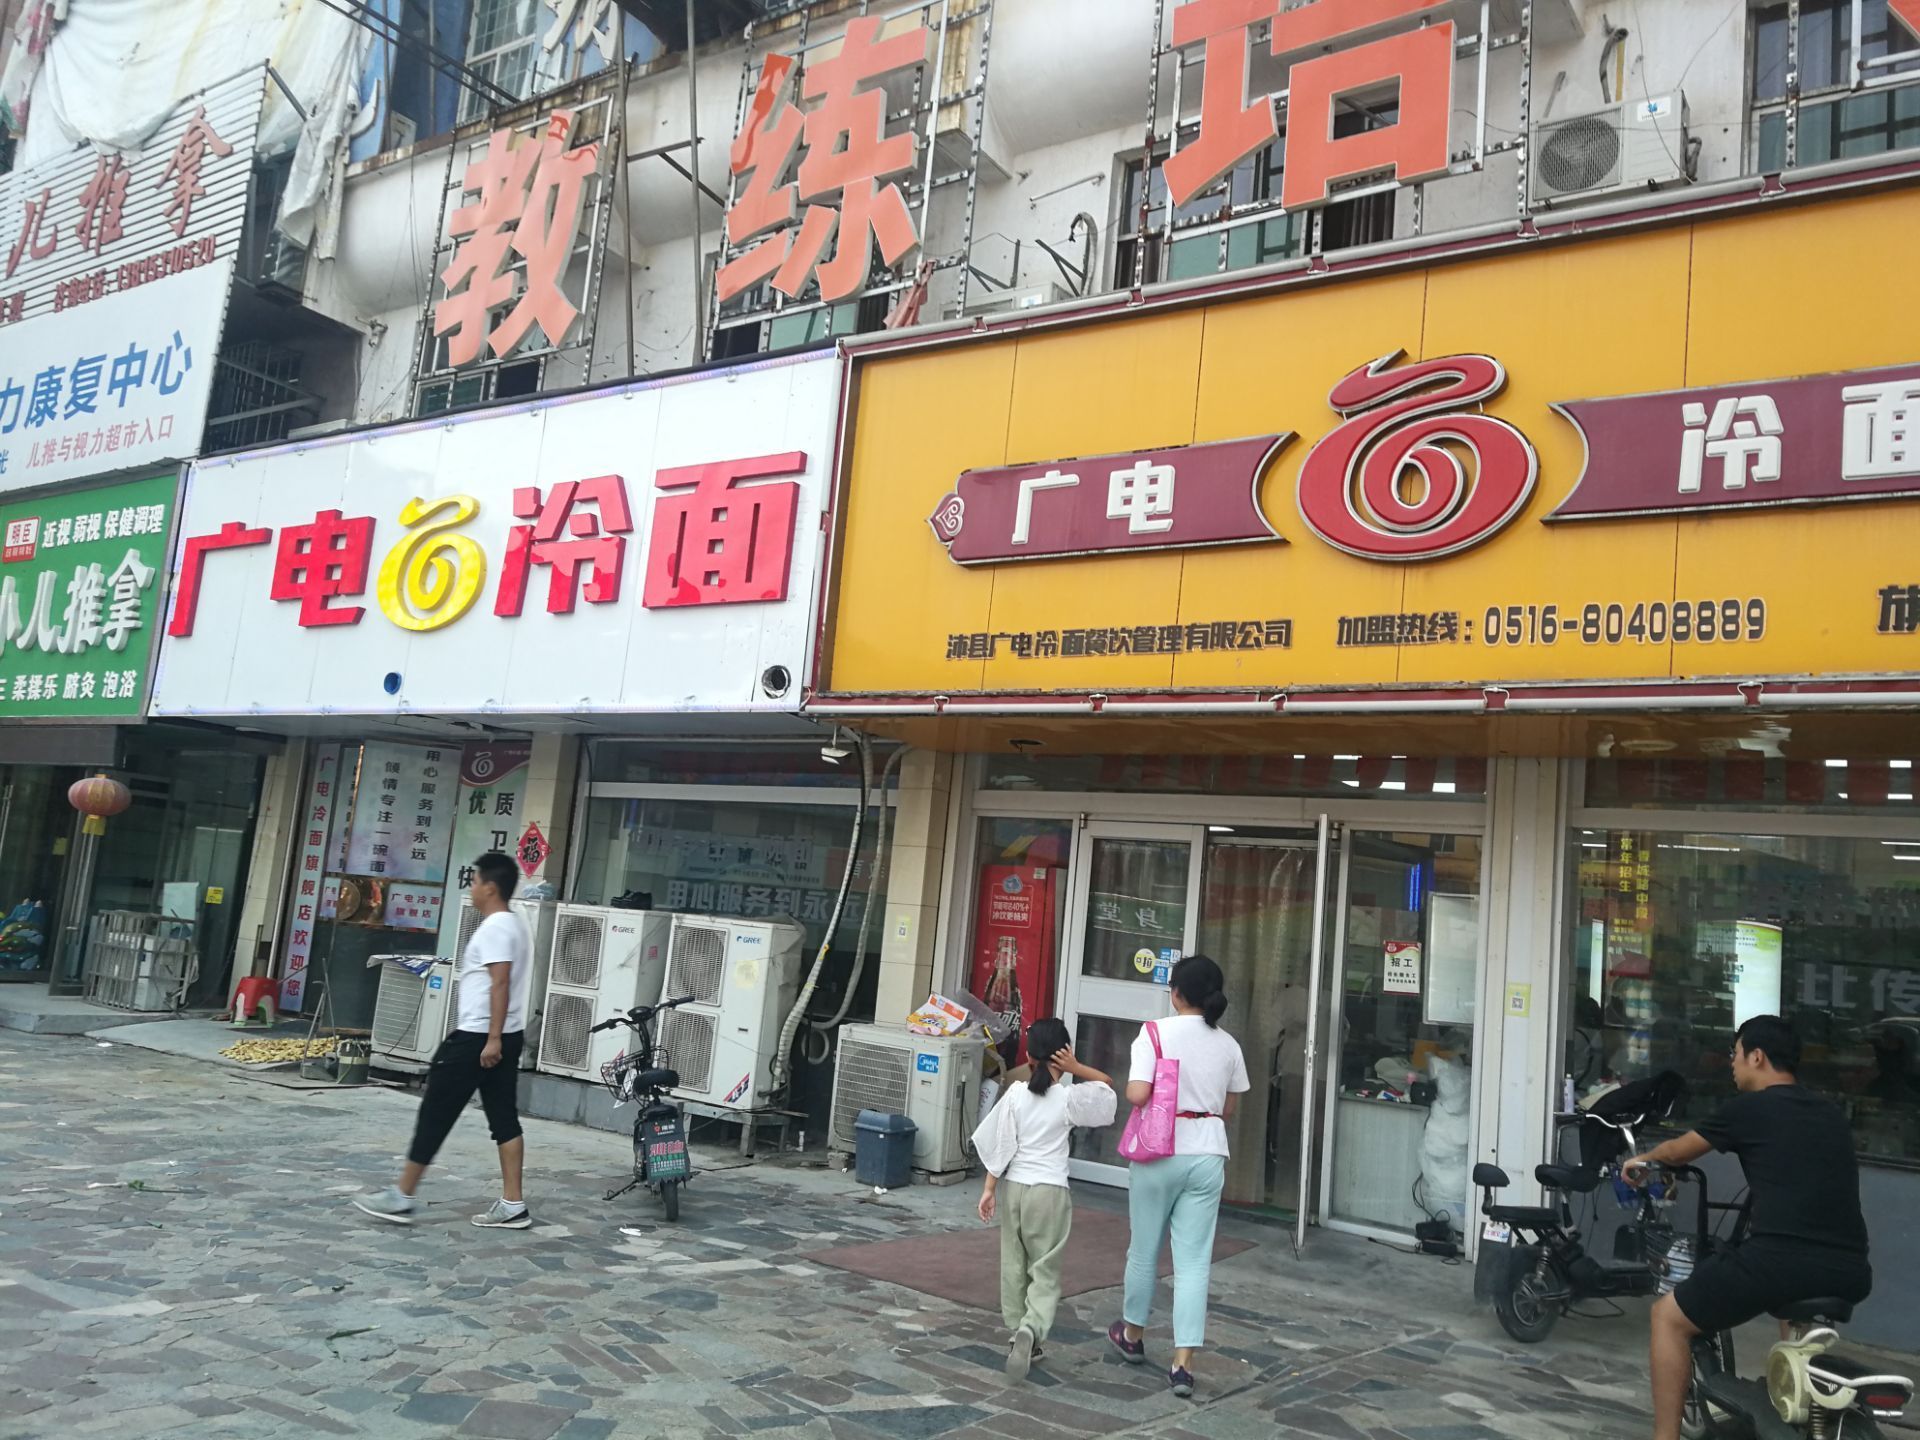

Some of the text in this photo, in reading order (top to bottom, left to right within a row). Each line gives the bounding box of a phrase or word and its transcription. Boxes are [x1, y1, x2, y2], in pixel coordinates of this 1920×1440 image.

[0, 329, 192, 434] 力康复中心
[26, 414, 173, 469] 儿推与视力超市入口
[1012, 377, 1920, 545] 广电 冷面
[42, 504, 165, 548] 近视 弱视 保健调理
[168, 451, 807, 638] 广电 冷面
[0, 548, 155, 656] 小儿推拿
[945, 619, 1294, 660] 沛县广电冷面餐饮管理有限公司
[101, 669, 138, 698] 泡浴
[369, 761, 401, 873] 倾情专注一碗面
[410, 750, 442, 861] 用心服务到永远
[469, 790, 515, 816] 优质
[286, 756, 335, 997] 广电冷面旗舰店欢迎您
[391, 892, 440, 905] 广电冷面
